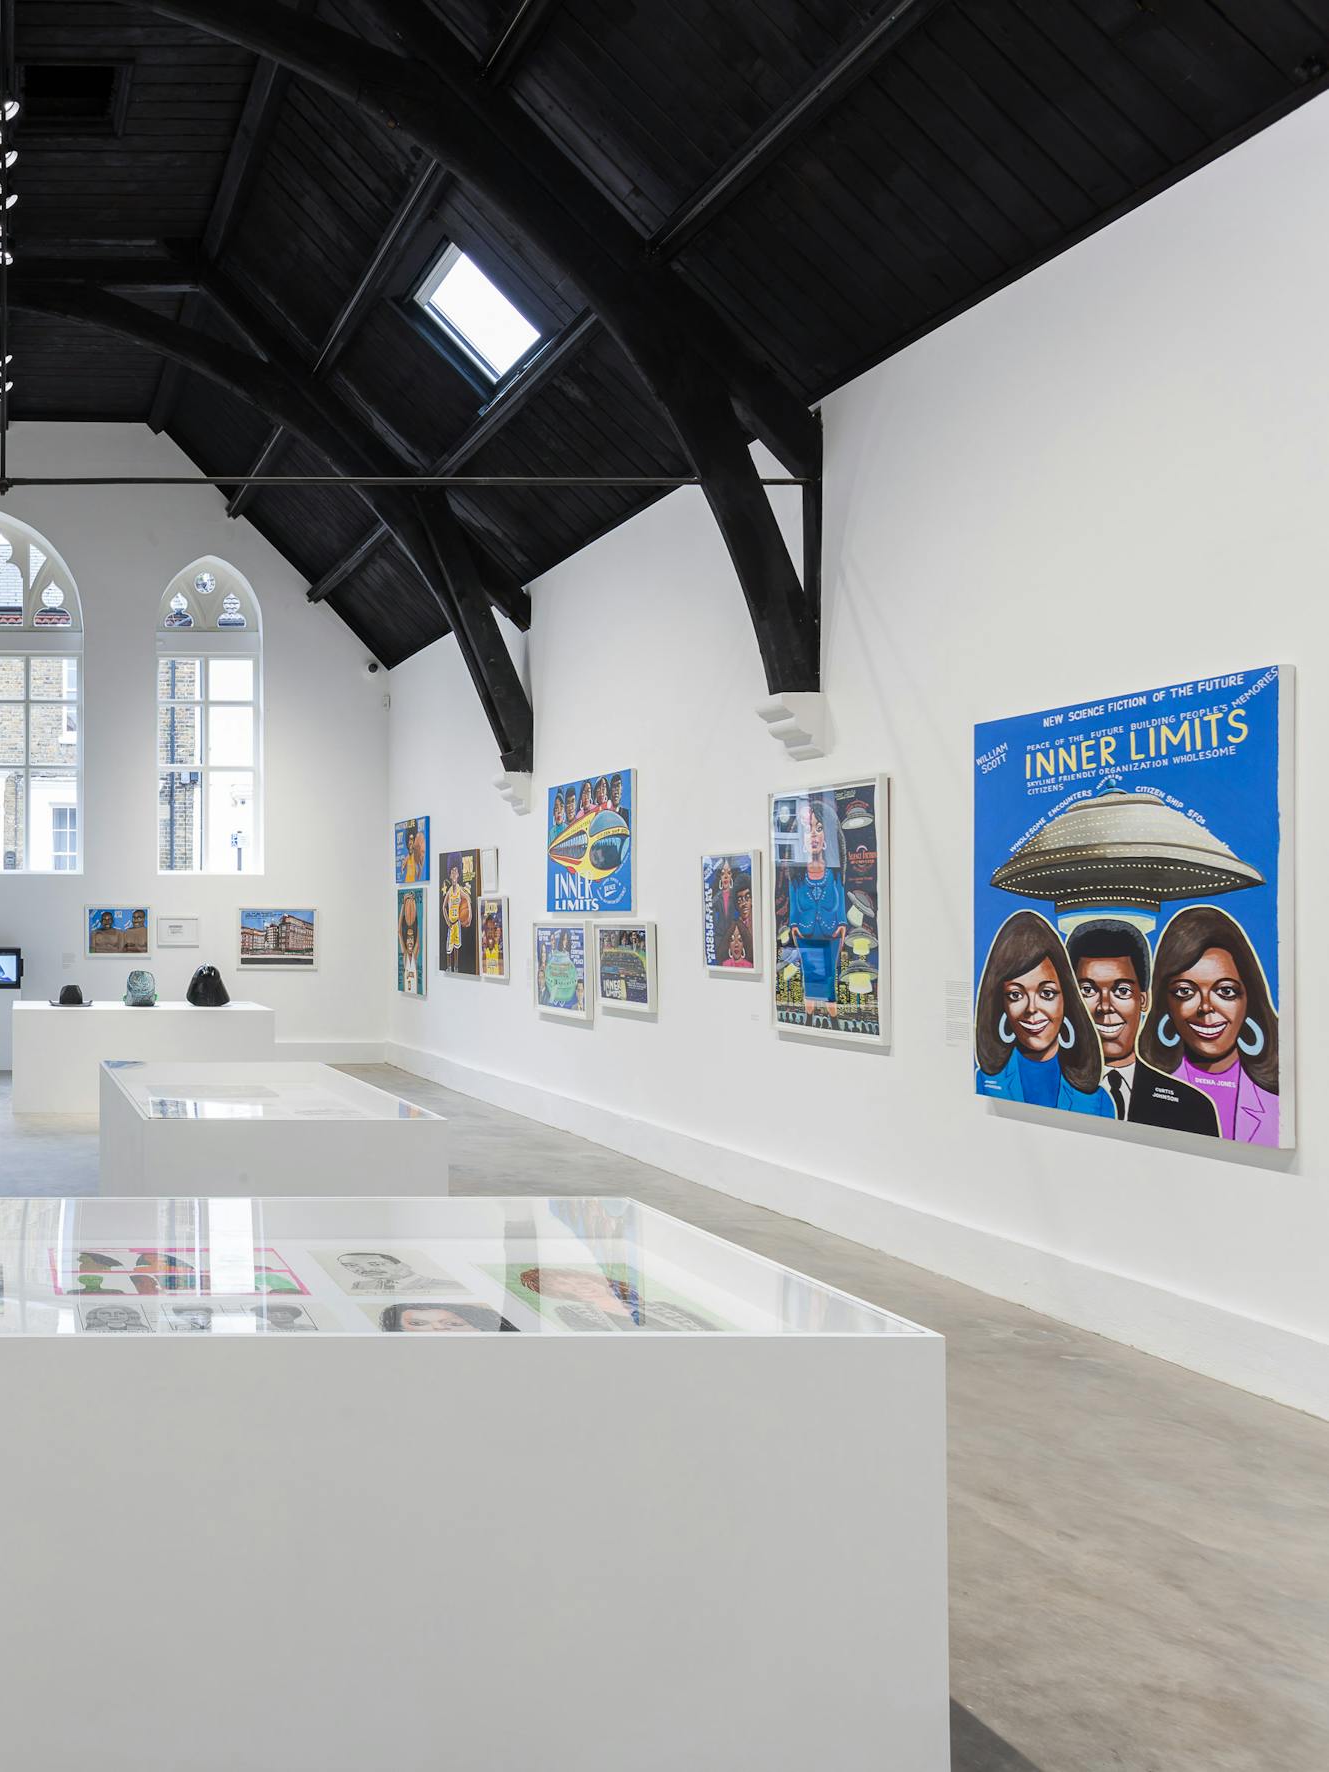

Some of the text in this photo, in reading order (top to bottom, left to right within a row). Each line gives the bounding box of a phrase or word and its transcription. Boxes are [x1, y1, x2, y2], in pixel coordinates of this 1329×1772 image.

[1026, 666, 1279, 751] PEACE OF THE FUTURE BUILDING PEOPLE'S MEMORIES
[1043, 673, 1245, 728] NEW SCIENCE FICTION OF THE FUTURE
[975, 742, 1009, 766] WILLIAM
[1025, 708, 1249, 780] INNER LIMITS
[981, 752, 1008, 775] SCOTT
[1026, 745, 1237, 788] SKYLINE FRIENDLY ORGANIZATION WHOLESOME
[1027, 783, 1064, 796] CITIZENS
[1135, 785, 1166, 799] CITIZEN
[1165, 795, 1184, 809] SHIP
[1008, 789, 1093, 853] WHOLESOME ENCOUNTERS
[554, 872, 593, 899] INNER
[555, 898, 600, 911] LIMITS
[1154, 1087, 1175, 1096] CURTIS
[1217, 1080, 1237, 1089] JONES
[1152, 1092, 1179, 1103] JOHNSON
